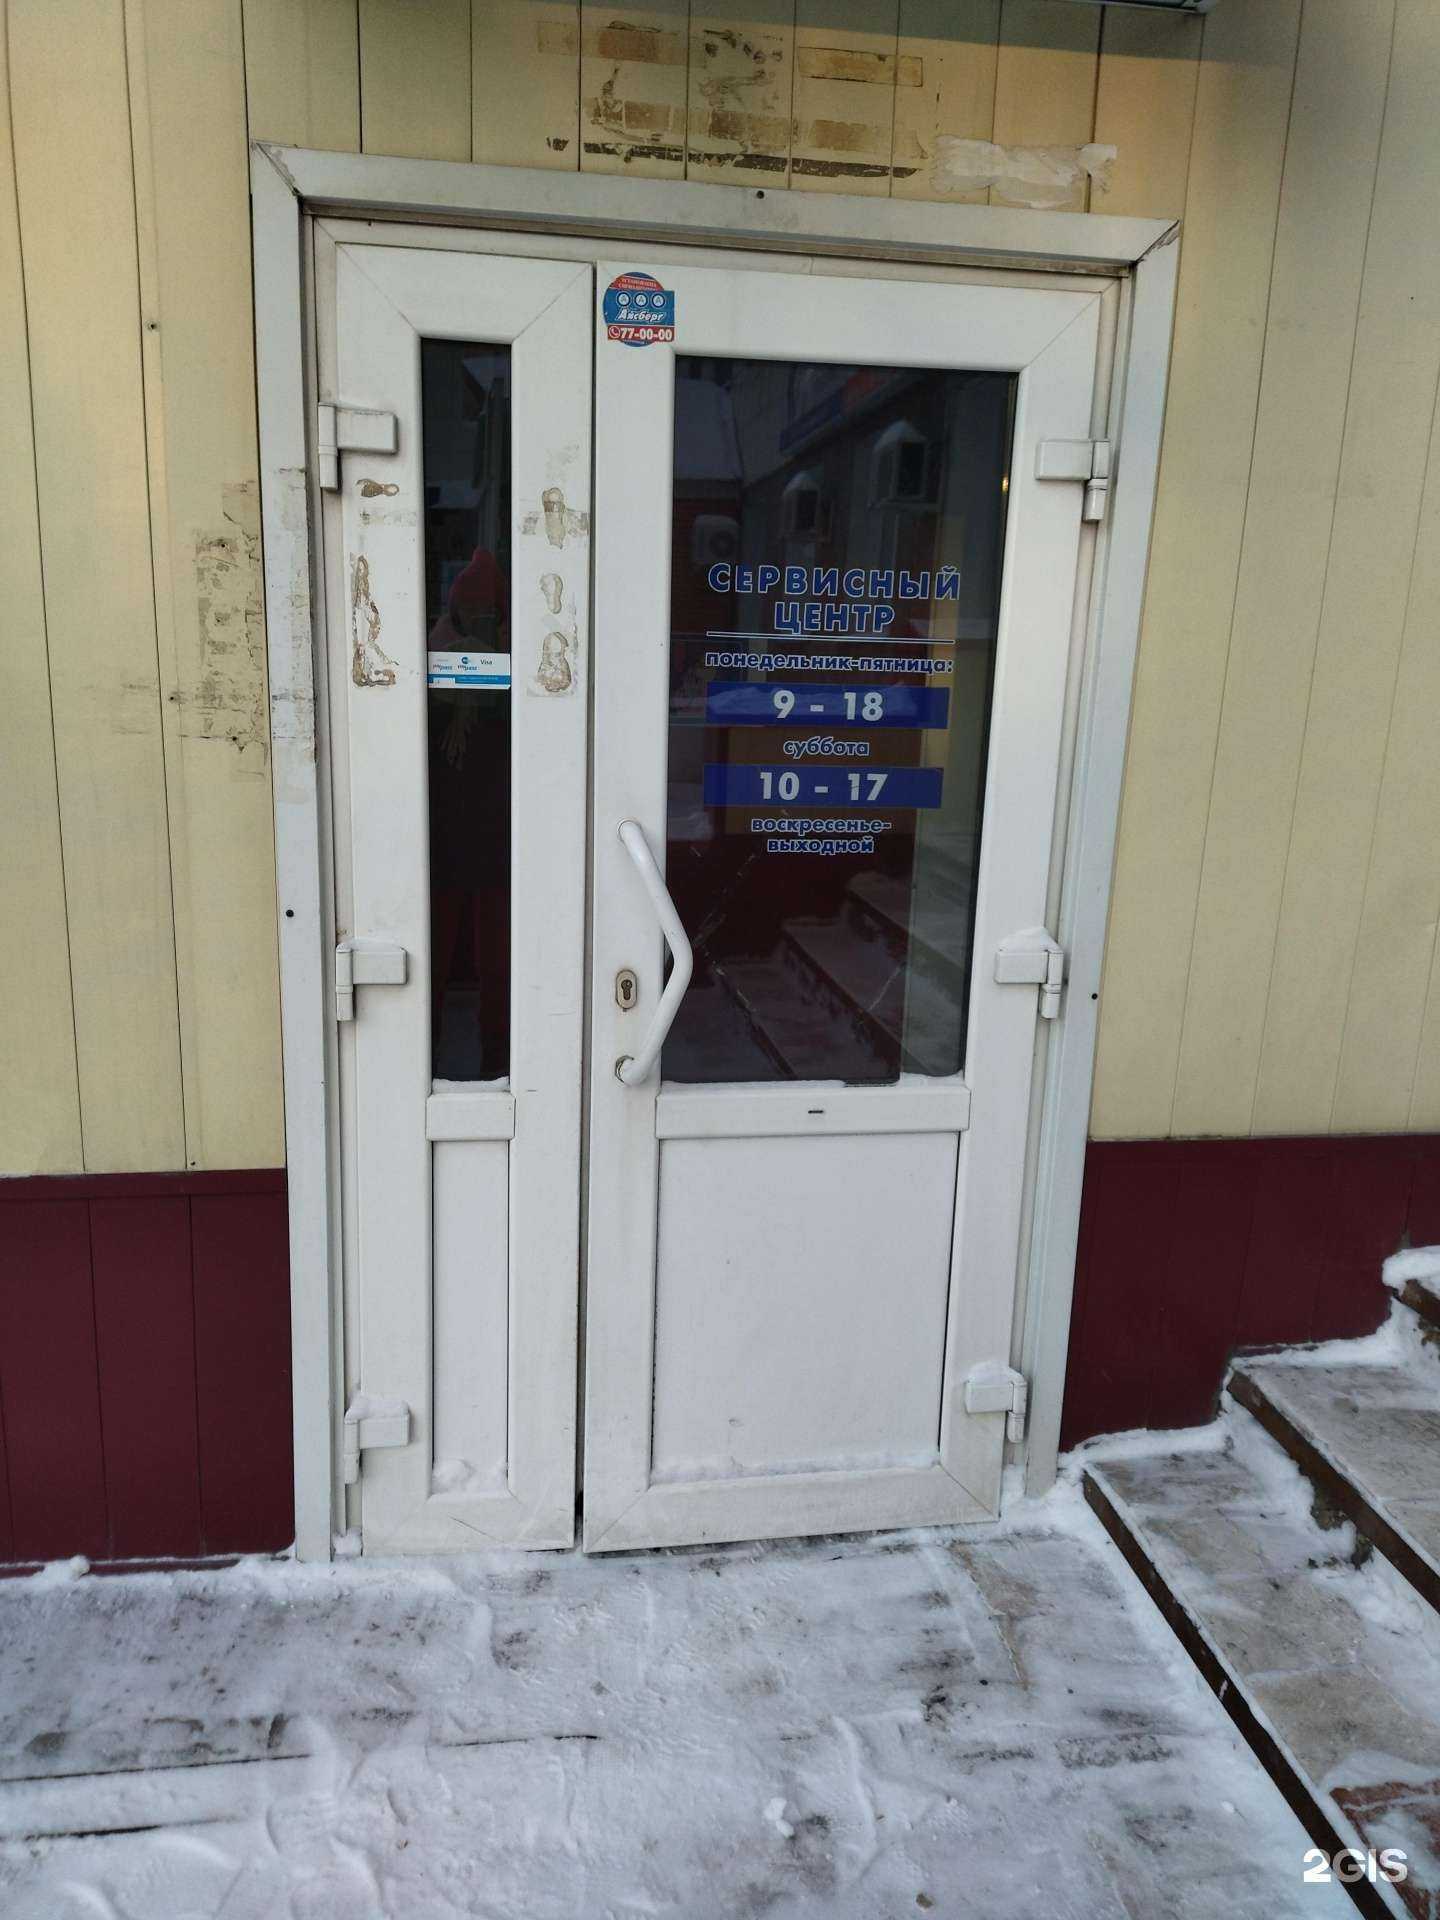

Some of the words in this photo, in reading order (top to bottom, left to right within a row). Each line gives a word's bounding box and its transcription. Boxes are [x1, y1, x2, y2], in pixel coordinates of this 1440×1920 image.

[620, 327, 672, 341] 77-00-00
[707, 562, 961, 600] СЕРВИСНЫЙ
[773, 601, 896, 634] ЦЕНТР
[704, 651, 955, 675] понедельник-пятница:
[773, 689, 796, 719] 9
[843, 690, 885, 722] 18
[783, 735, 870, 760] суббота
[759, 771, 801, 801] 10
[847, 772, 889, 801] 17
[751, 816, 892, 837] воскресенье-
[767, 834, 874, 856] выходной
